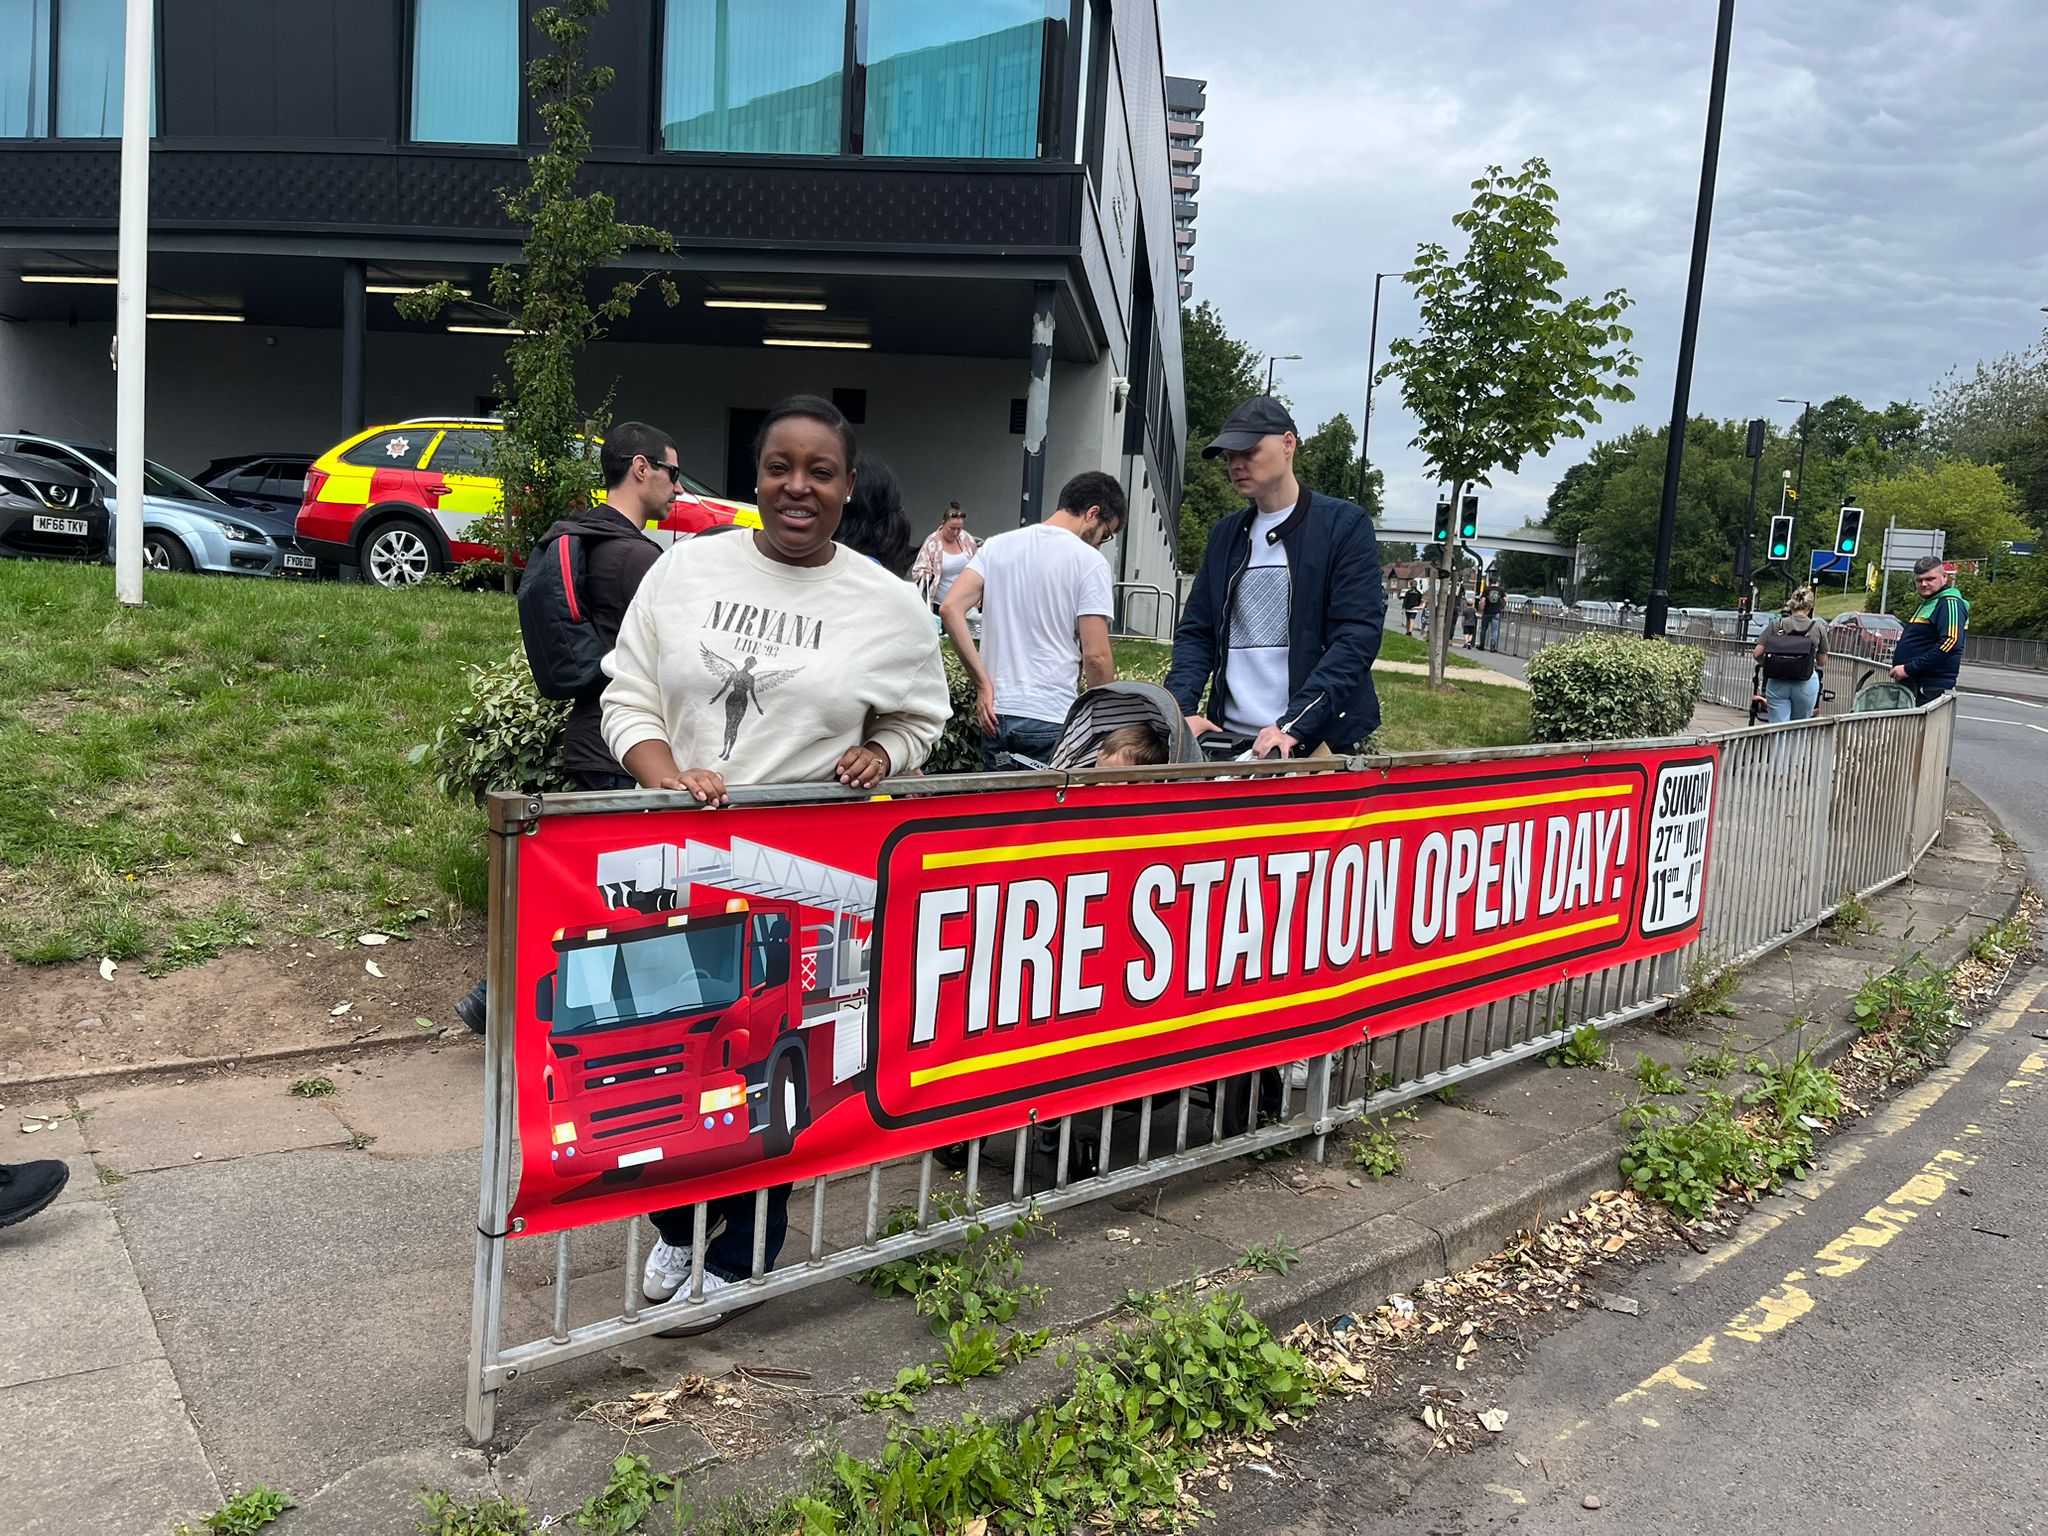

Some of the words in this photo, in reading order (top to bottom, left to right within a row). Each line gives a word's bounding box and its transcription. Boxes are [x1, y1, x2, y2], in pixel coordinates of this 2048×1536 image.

[39, 517, 65, 530] MF66
[702, 600, 823, 650] NIRVANA
[734, 637, 762, 655] LIVE
[1658, 771, 1711, 819] SUNDAY
[1654, 824, 1684, 864] 27TH
[1684, 817, 1706, 859] JULY
[910, 871, 1109, 1045] FIRE
[1125, 837, 1402, 1002] STATION
[1411, 820, 1535, 945] OPEN
[1538, 807, 1631, 916] DAY!
